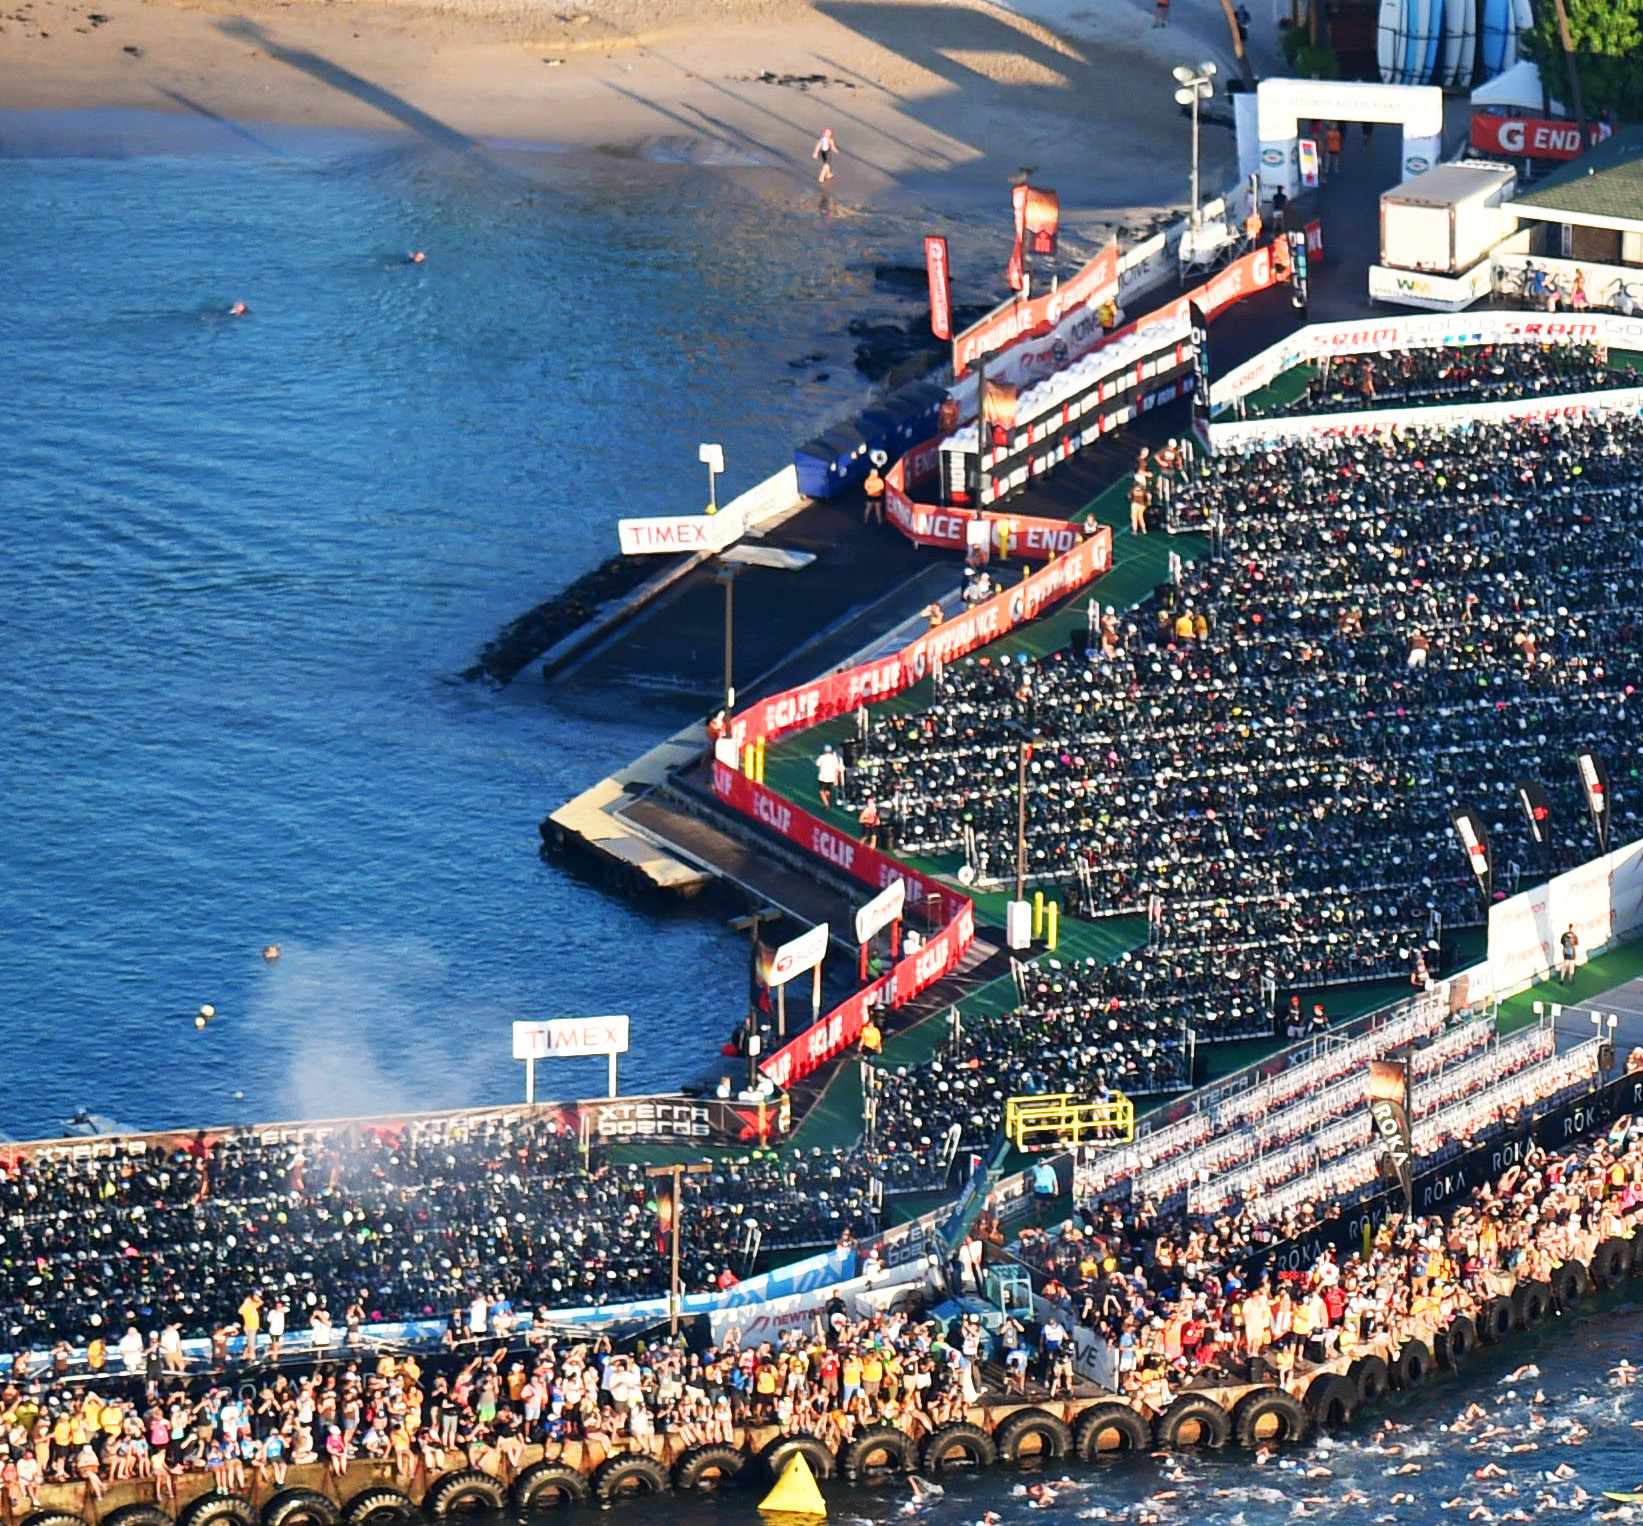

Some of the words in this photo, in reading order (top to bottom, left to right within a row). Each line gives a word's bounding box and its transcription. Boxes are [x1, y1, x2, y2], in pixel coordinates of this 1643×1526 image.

[1314, 329, 1397, 347] SRAM
[1504, 322, 1597, 338] SRAM
[628, 524, 707, 546] TIMEX
[758, 799, 792, 832] CLIF
[820, 836, 855, 869] CLIF
[922, 938, 949, 978] CLIF
[525, 1026, 618, 1050] TIMEX
[599, 1105, 710, 1120] XTERRA
[598, 1121, 711, 1137] boards
